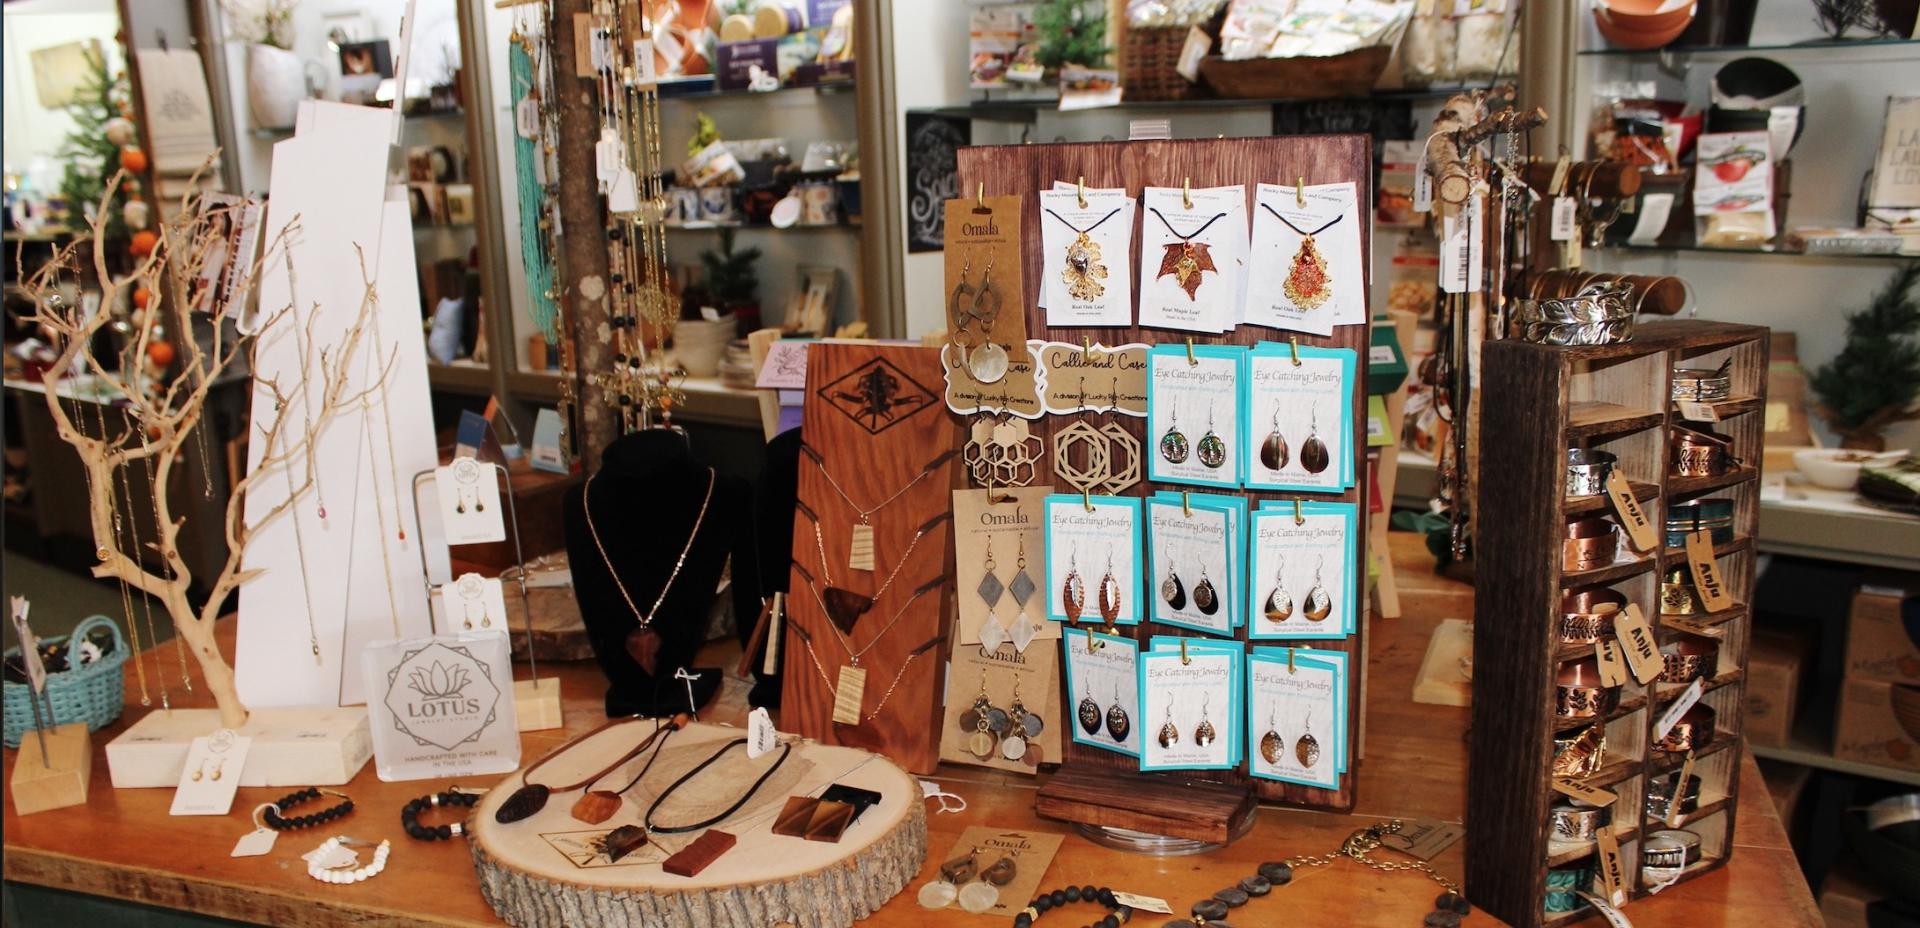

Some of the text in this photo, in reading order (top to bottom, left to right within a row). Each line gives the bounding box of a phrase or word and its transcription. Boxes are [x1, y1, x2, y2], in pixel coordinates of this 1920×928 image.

[962, 216, 999, 237] Omala
[1092, 353, 1114, 369] and
[1118, 352, 1147, 370] Case
[1155, 367, 1236, 387] Eye Catching Jewelry
[1254, 369, 1341, 387] Eye Catching Jewelry
[980, 506, 1029, 526] Omala
[1621, 493, 1645, 527] Anju
[1053, 514, 1132, 530] Eye Catching Jewelry
[1153, 516, 1167, 529] Eye
[1168, 518, 1198, 534] Catching
[1197, 520, 1225, 538] Jewelry
[1259, 527, 1344, 543] Eye Catching Jewelry
[1700, 563, 1721, 599] Anju
[1071, 645, 1084, 656] Eye
[1630, 627, 1653, 660] Anju
[1148, 667, 1229, 680] Eye Catching Jewelry
[1254, 673, 1269, 685] Eye
[1270, 675, 1304, 690] Catching
[1301, 678, 1332, 696] Jewelry
[408, 699, 481, 718] LOTUS
[405, 752, 458, 763] HANDCRAFTED
[460, 751, 479, 759] WITH
[1562, 778, 1596, 794] Anju
[984, 838, 1032, 851] Omala
[1607, 852, 1622, 887] Anju
